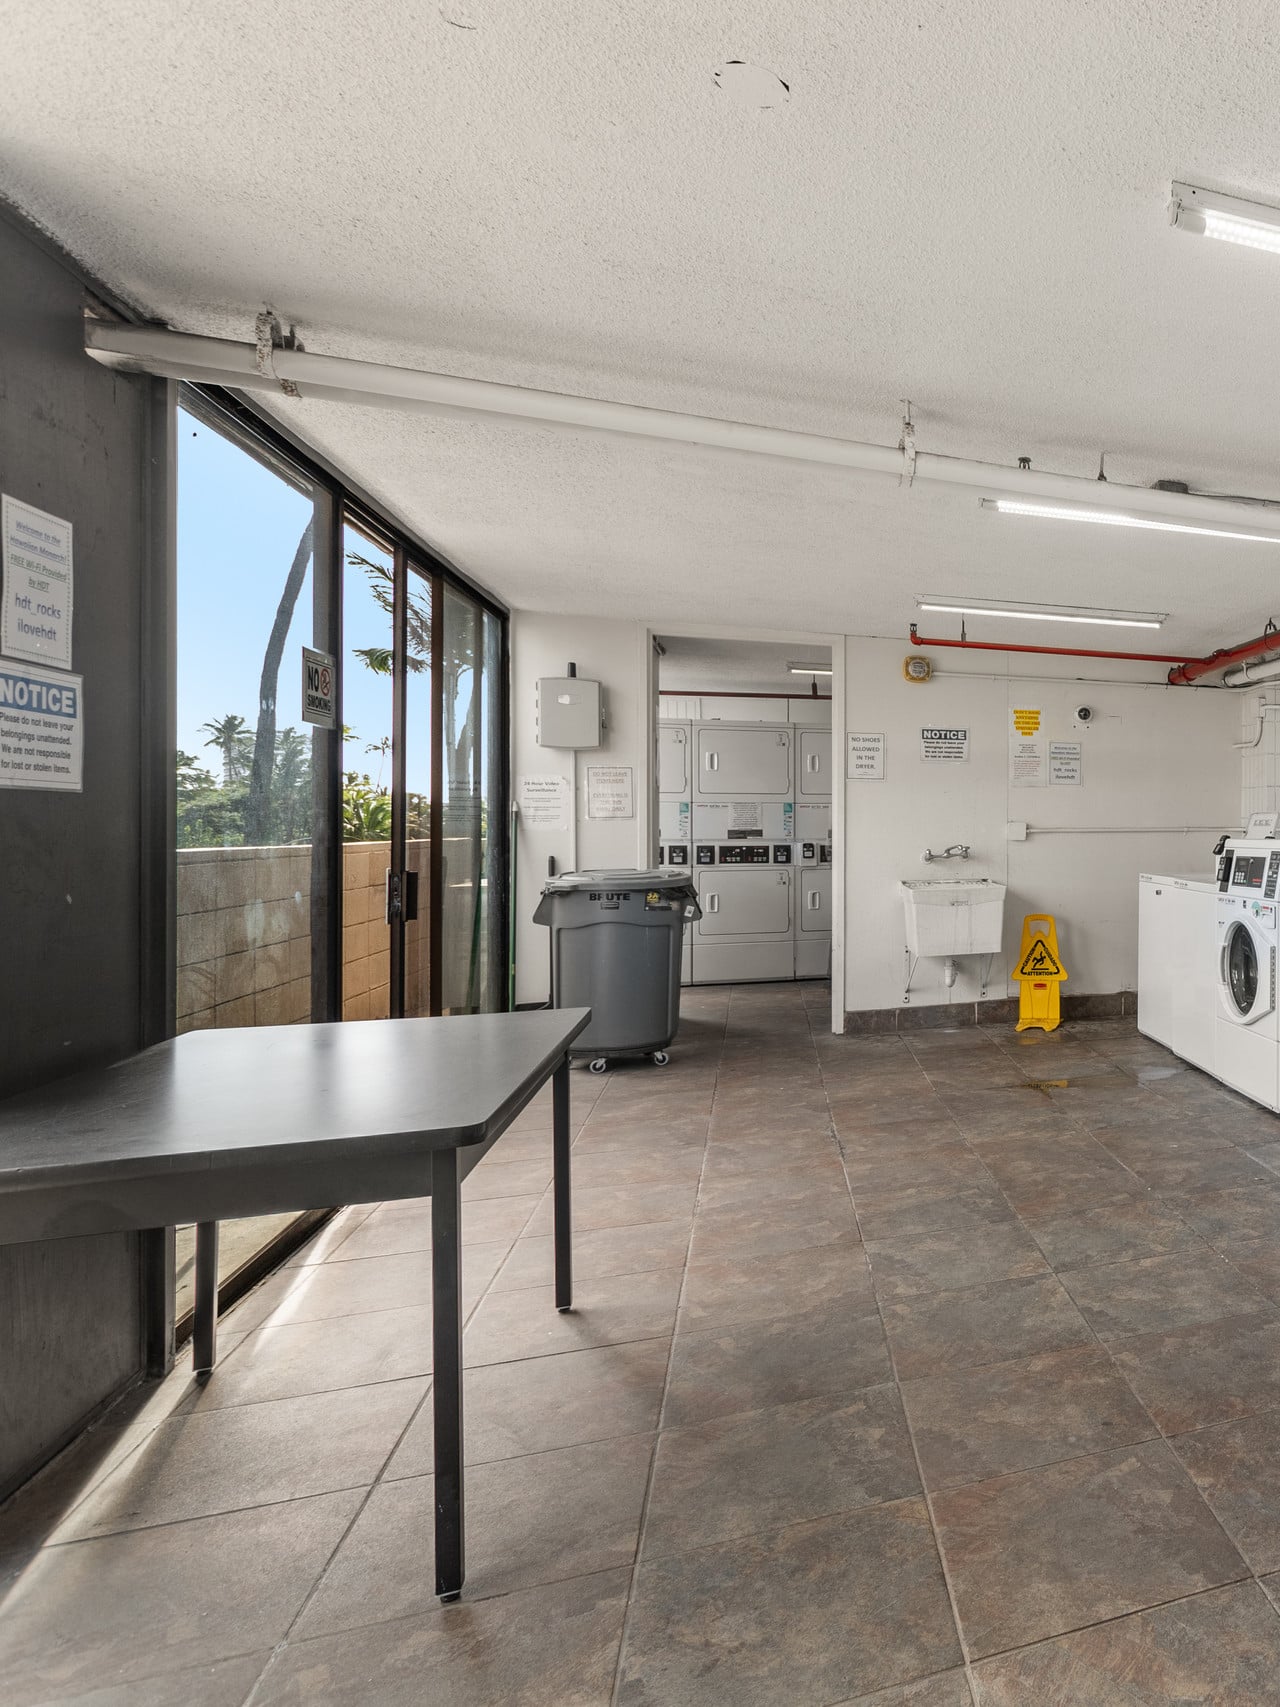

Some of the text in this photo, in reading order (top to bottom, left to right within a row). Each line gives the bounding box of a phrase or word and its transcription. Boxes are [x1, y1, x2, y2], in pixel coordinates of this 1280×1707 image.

[15, 520, 60, 544] Welcome to the
[10, 553, 67, 581] FREE Wi-Fi Provided
[28, 577, 50, 591] by HDT
[15, 592, 61, 620] hdt_rocks
[17, 618, 57, 641] ilovehdt
[307, 665, 319, 692] NO
[0, 678, 75, 714] NOTICE
[307, 694, 331, 713] SMOKING
[0, 711, 74, 732] Please do not leave your
[0, 727, 72, 746] belongings unattended.
[923, 730, 965, 739] NOTICE
[1, 743, 71, 760] We are not responsible
[0, 759, 71, 774] for lost or stolen items.
